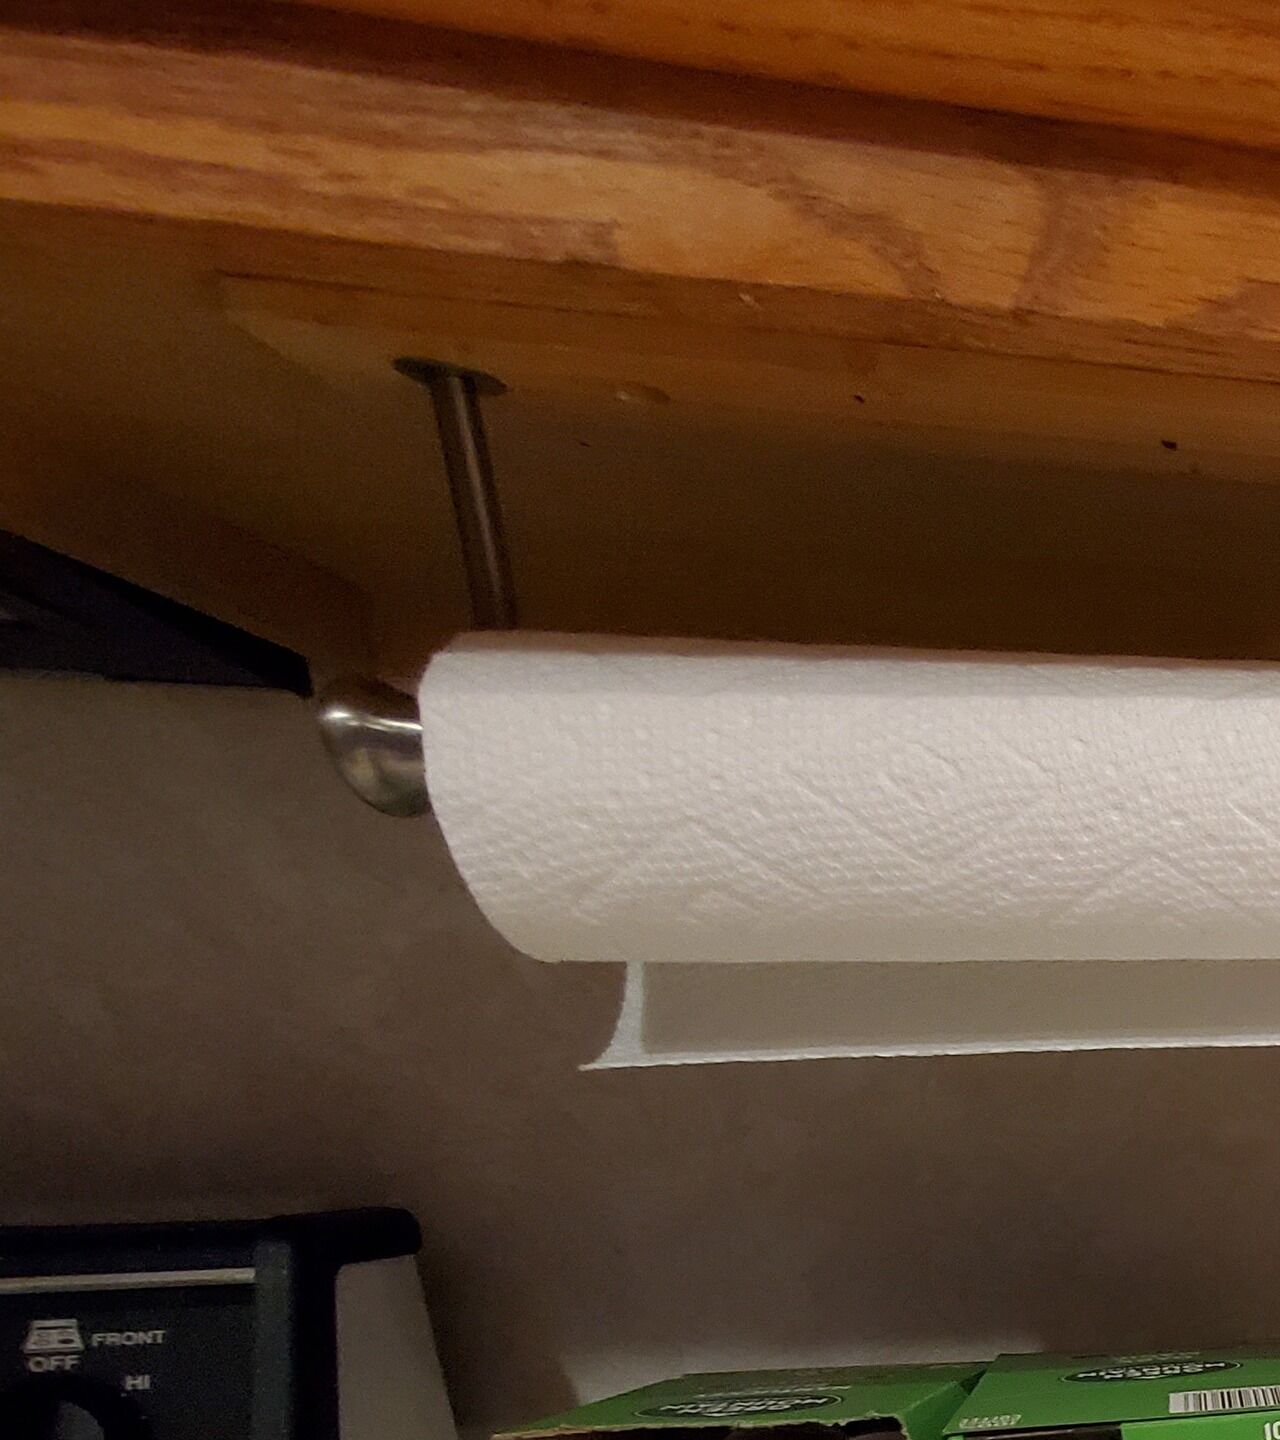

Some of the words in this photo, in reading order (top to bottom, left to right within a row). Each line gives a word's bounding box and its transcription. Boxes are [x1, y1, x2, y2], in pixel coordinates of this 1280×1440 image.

[91, 1330, 166, 1347] FRONT
[28, 1355, 81, 1373] OFF
[124, 1374, 150, 1391] HI
